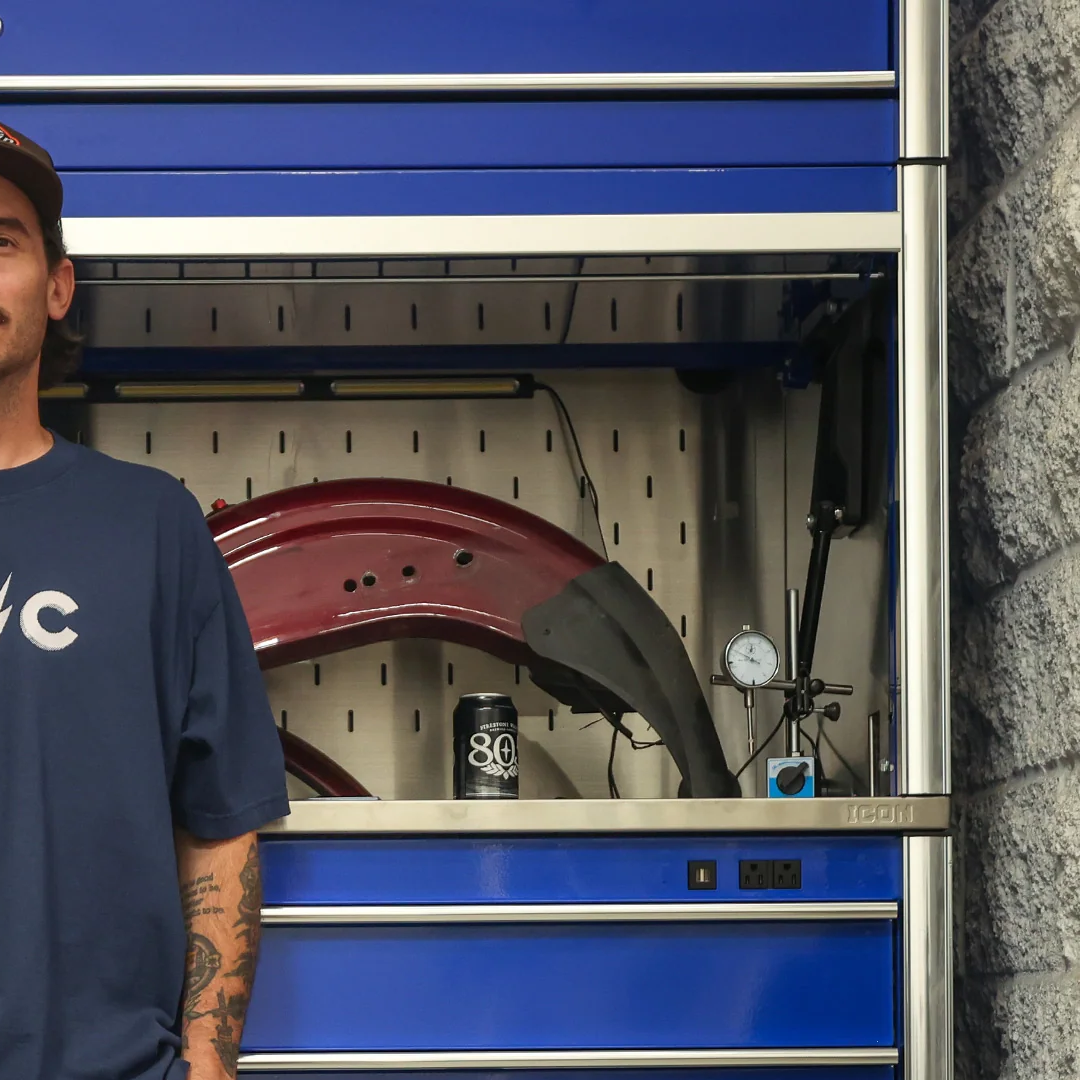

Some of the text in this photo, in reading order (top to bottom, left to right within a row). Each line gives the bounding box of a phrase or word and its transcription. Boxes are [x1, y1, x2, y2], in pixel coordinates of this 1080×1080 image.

[20, 590, 79, 651] C
[468, 732, 515, 767] 80
[847, 804, 913, 824] ICON
